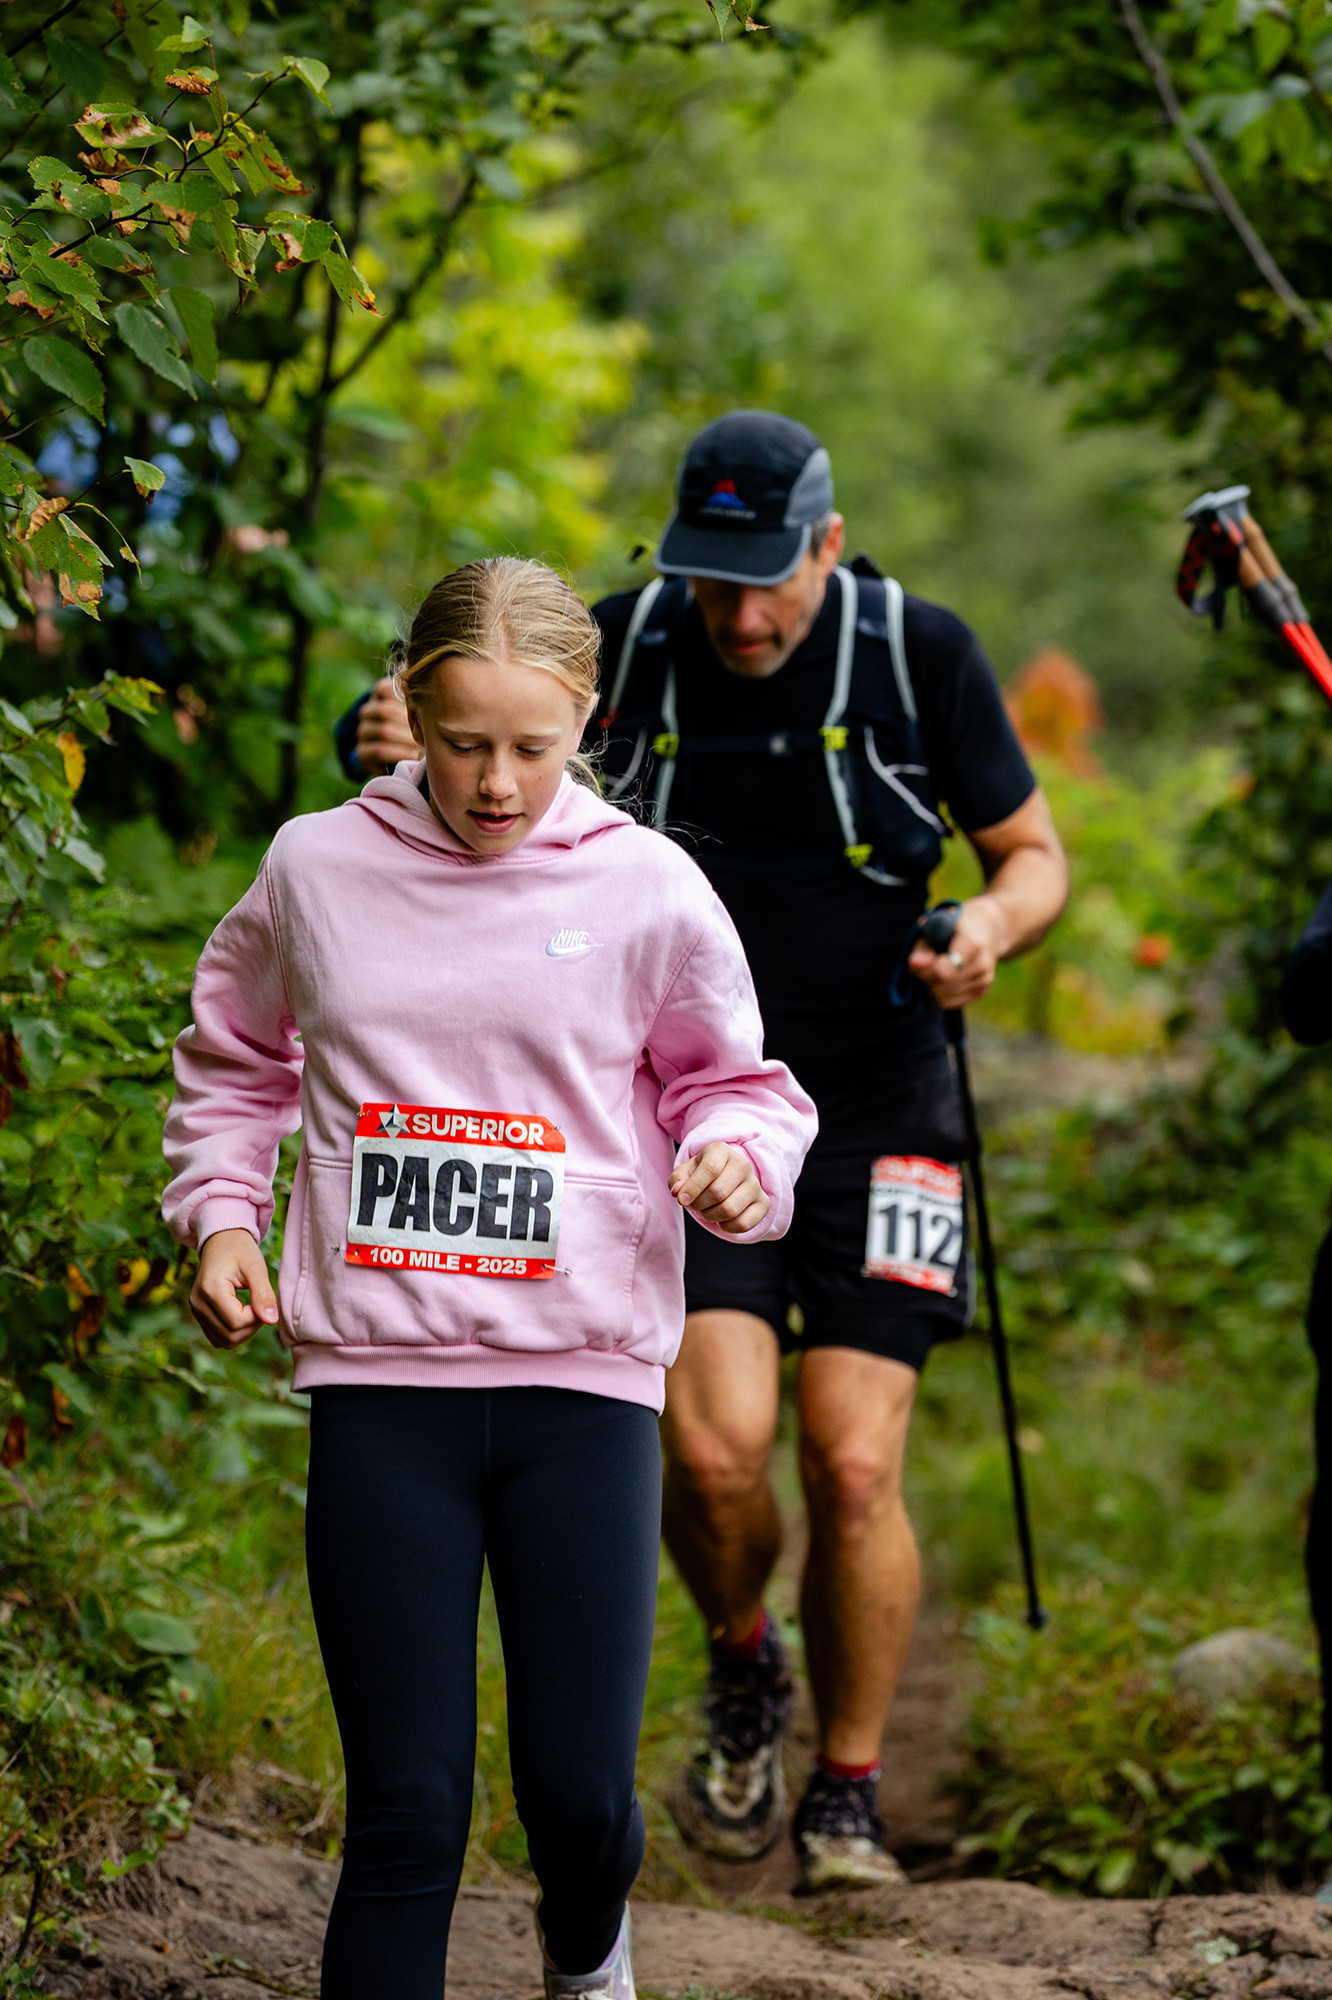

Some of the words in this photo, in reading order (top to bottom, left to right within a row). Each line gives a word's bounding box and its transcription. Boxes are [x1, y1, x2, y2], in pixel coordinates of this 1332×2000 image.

[555, 927, 589, 947] NIKE
[412, 1113, 544, 1146] SUPERIOR
[356, 1152, 554, 1243] PACER
[879, 1204, 958, 1268] 112
[370, 1247, 404, 1265] 100
[409, 1251, 460, 1271] MILE
[476, 1257, 527, 1275] 2025
